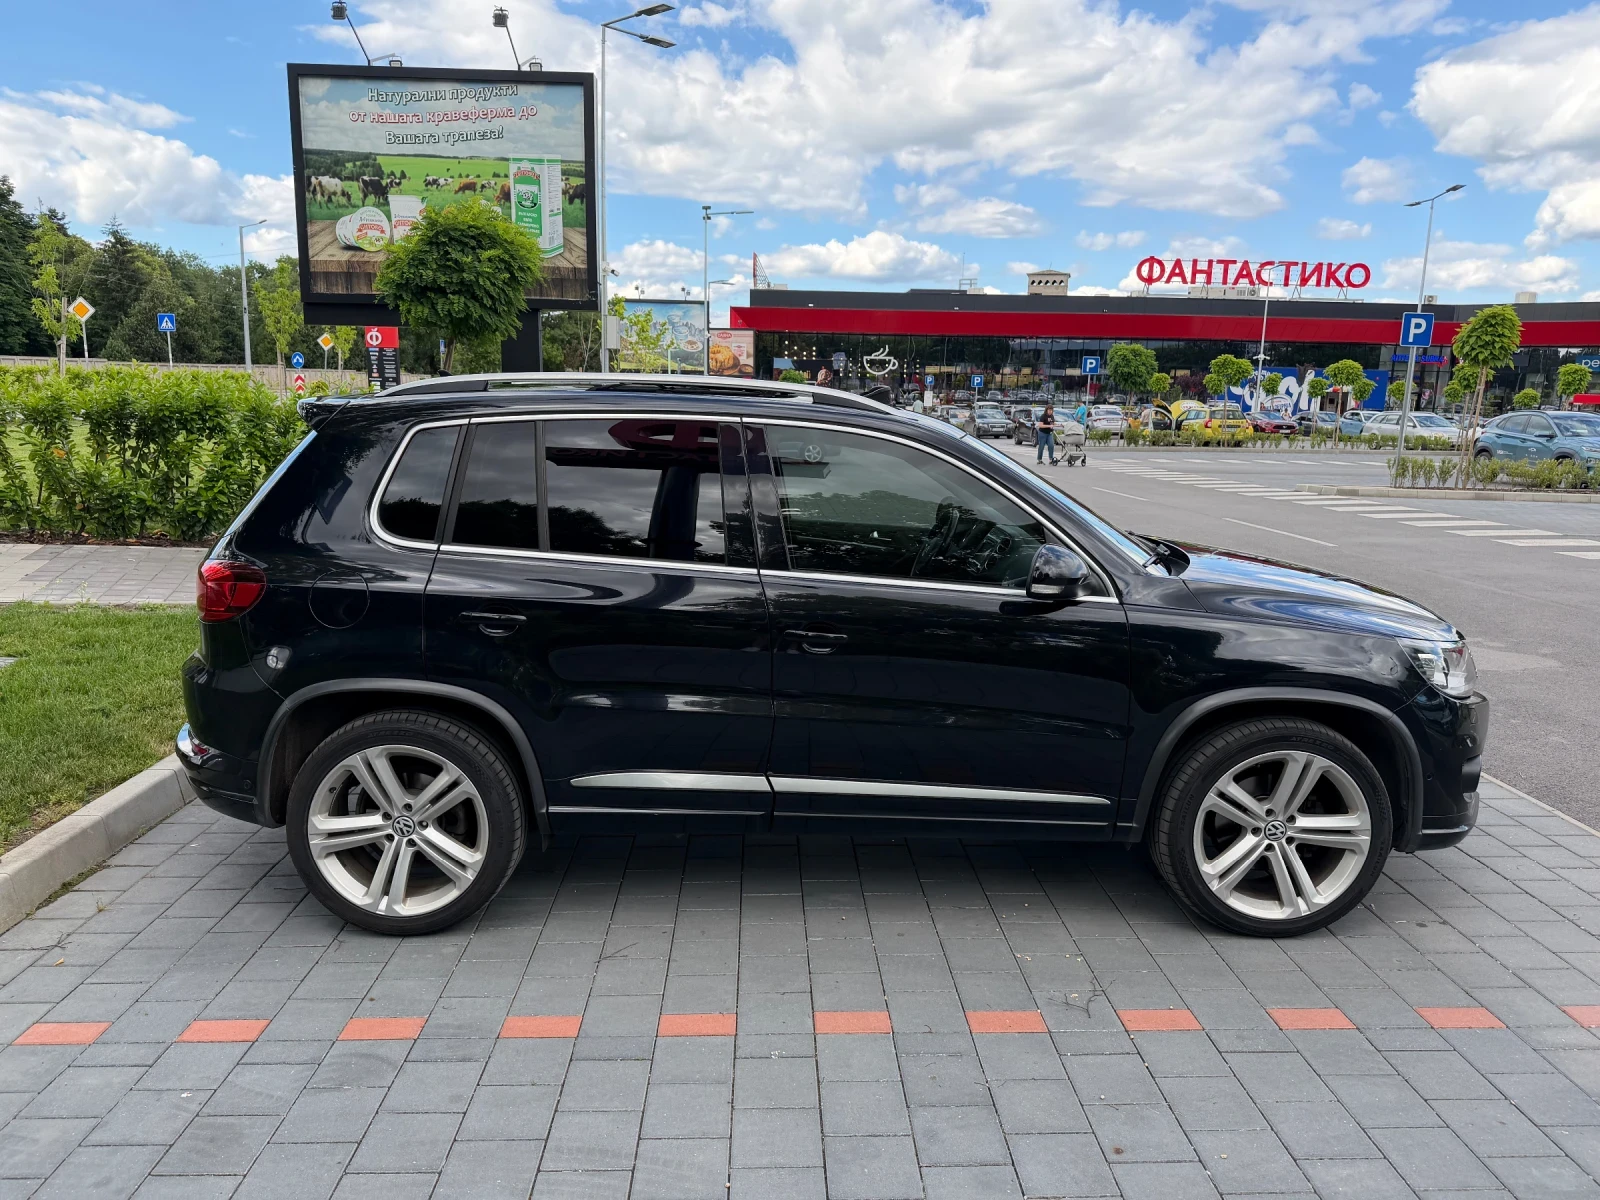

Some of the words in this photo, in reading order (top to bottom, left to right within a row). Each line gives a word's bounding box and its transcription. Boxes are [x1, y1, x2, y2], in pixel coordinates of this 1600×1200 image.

[368, 88, 446, 106] Натурални
[448, 84, 519, 103] продукти
[349, 111, 366, 123] от
[370, 111, 424, 124] нашата
[426, 105, 516, 126] кравеферма
[518, 105, 538, 121] до
[385, 131, 440, 145] Вашата
[442, 126, 504, 146] трапеза!
[1136, 255, 1371, 289] ФАНТАСТИКО
[1408, 317, 1427, 343] P
[1086, 359, 1096, 372] P
[926, 377, 933, 385] P
[974, 376, 981, 385] P
